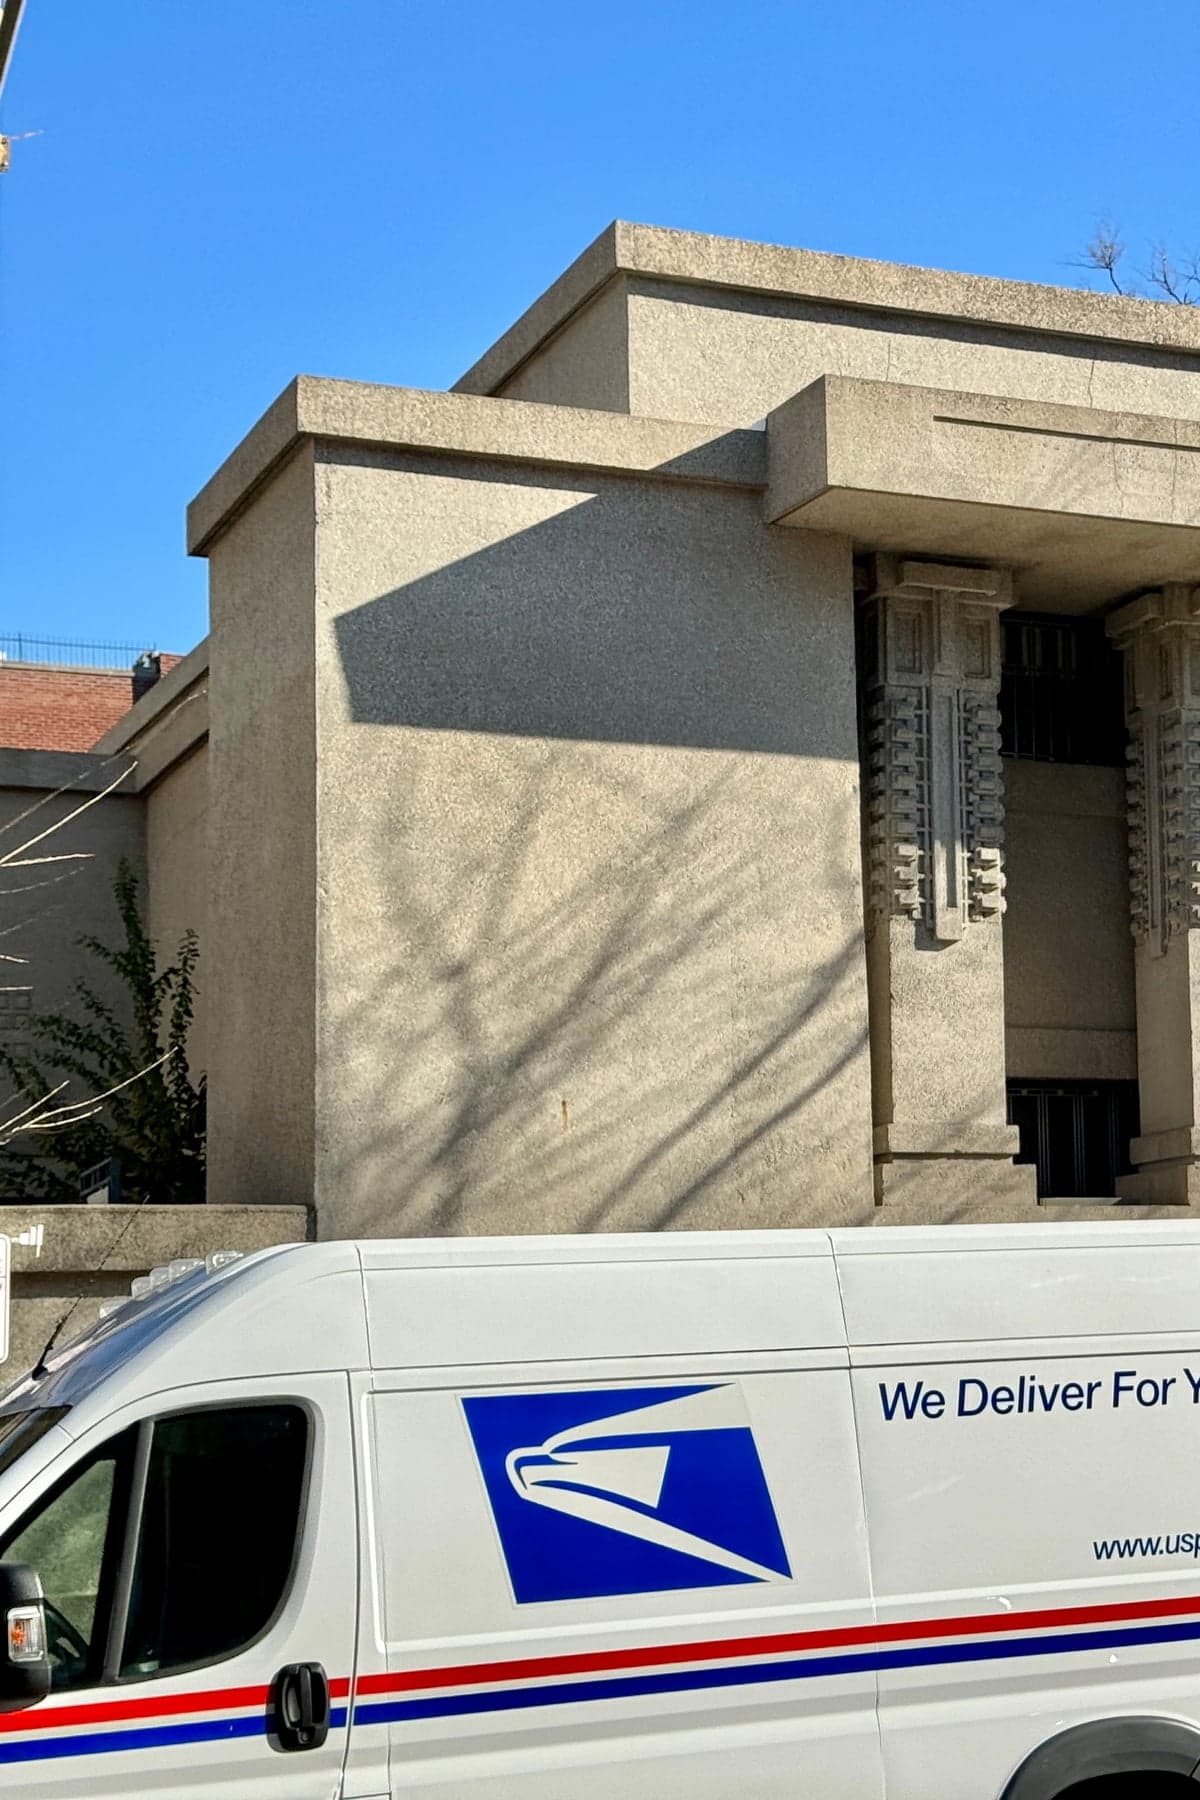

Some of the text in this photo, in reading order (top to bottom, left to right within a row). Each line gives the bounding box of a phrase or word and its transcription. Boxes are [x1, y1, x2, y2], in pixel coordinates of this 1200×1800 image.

[879, 1381, 946, 1421] We
[957, 1375, 1102, 1417] Deliver
[1112, 1370, 1176, 1408] For
